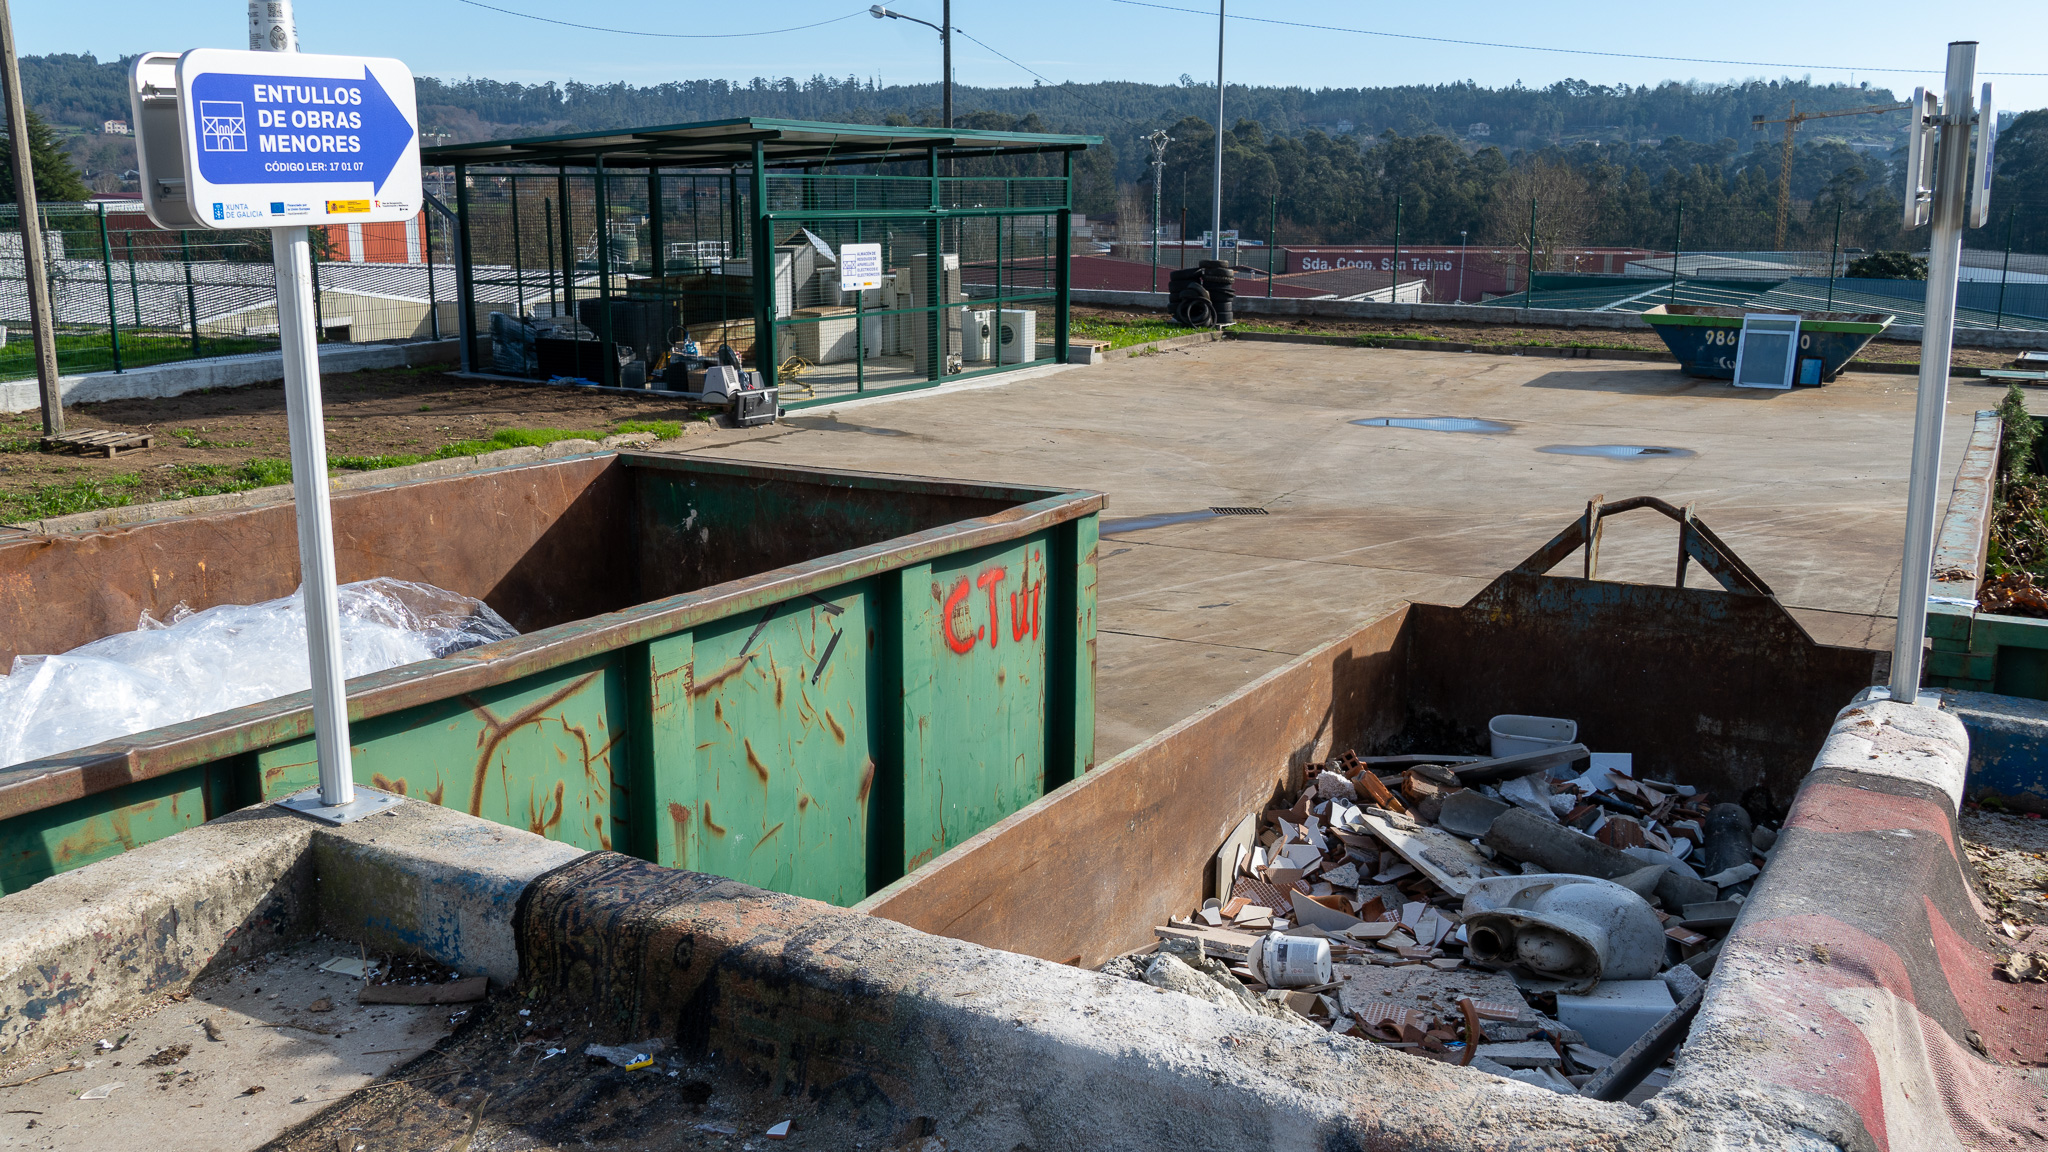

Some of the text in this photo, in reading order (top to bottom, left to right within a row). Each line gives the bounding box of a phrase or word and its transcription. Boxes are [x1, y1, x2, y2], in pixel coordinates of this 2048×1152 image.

[253, 84, 362, 105] ENTULLOS
[258, 109, 362, 129] DE OBRAS
[259, 134, 361, 153] MENORES
[265, 161, 364, 172] CÓDIGO LER: 17 01 07
[225, 203, 249, 211] XUNTA
[1302, 256, 1332, 270] Sda.
[1411, 258, 1453, 271] Telmo
[1705, 330, 1736, 346] 986
